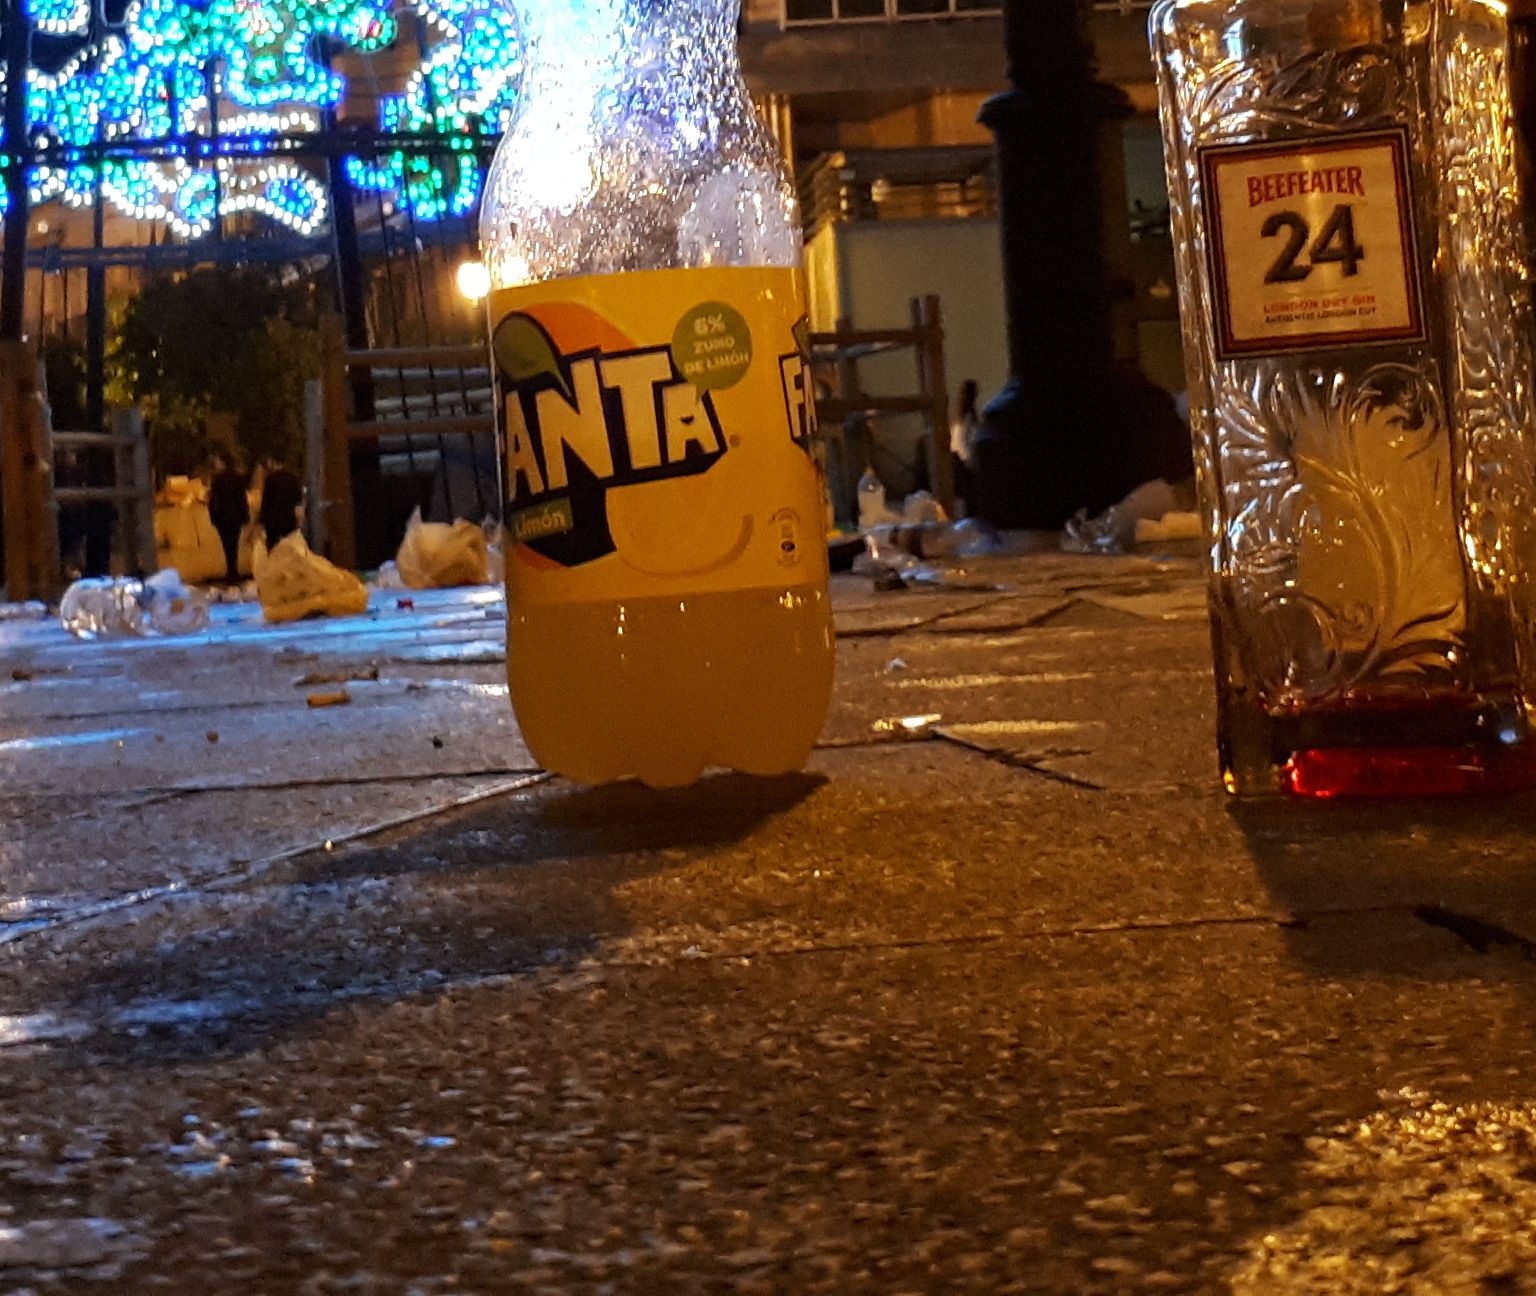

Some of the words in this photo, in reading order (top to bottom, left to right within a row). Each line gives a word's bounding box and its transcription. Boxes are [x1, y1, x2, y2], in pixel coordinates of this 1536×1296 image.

[1247, 166, 1365, 207] BEEFEATER
[1261, 205, 1364, 286] 24
[693, 335, 736, 355] ZUMO
[684, 359, 705, 373] DE
[501, 351, 721, 502] ANTA
